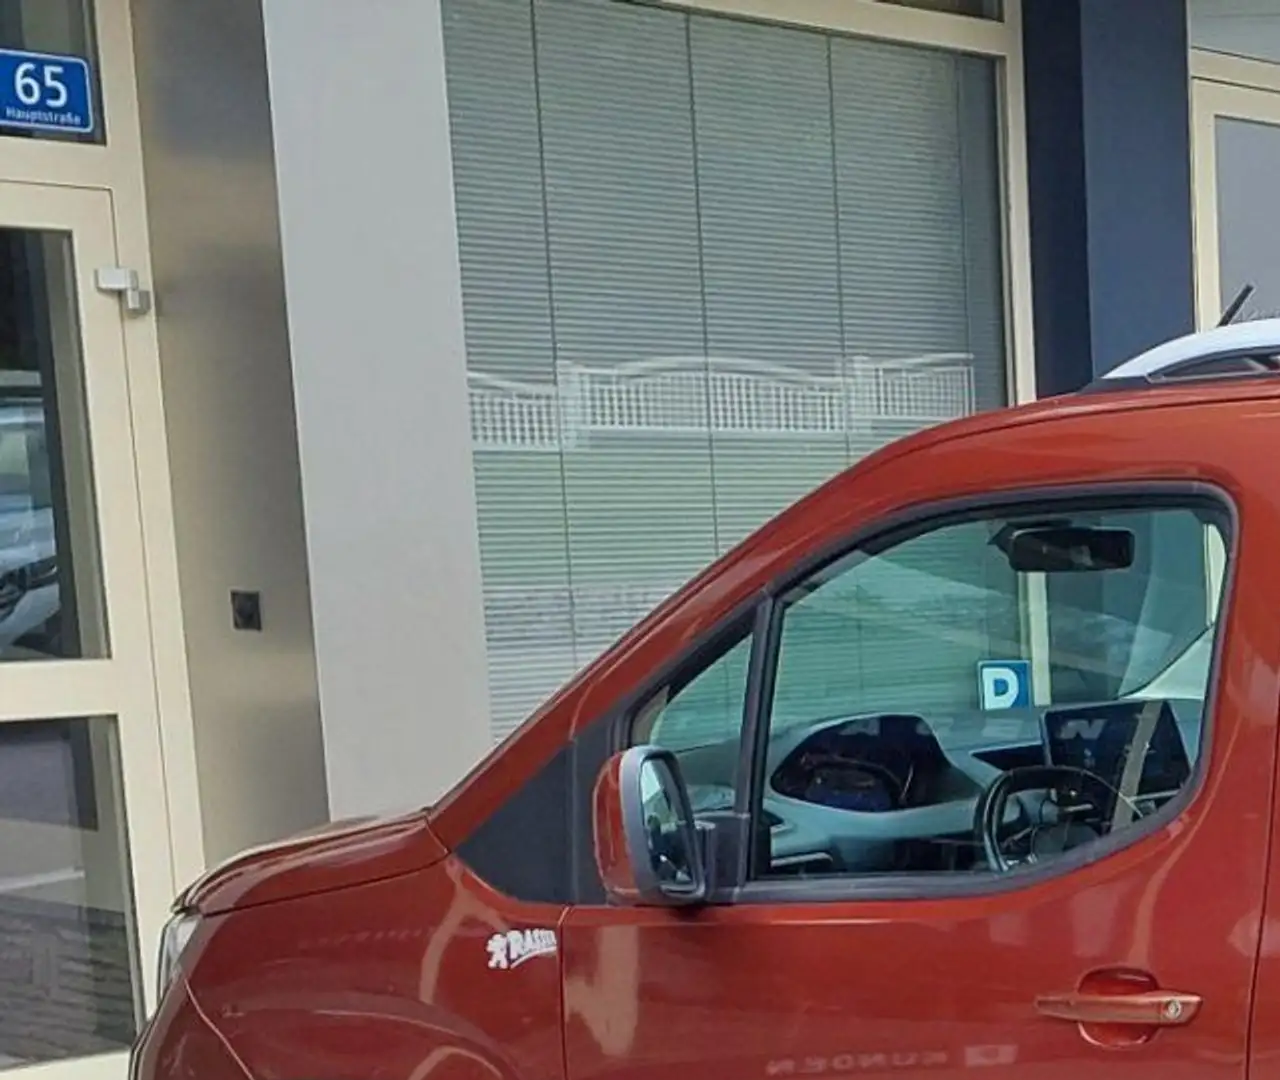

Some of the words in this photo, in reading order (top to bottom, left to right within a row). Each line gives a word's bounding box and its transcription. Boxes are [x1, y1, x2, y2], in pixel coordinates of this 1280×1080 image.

[14, 62, 68, 108] 65
[5, 106, 82, 125] Hauptstraße
[982, 667, 1019, 711] D
